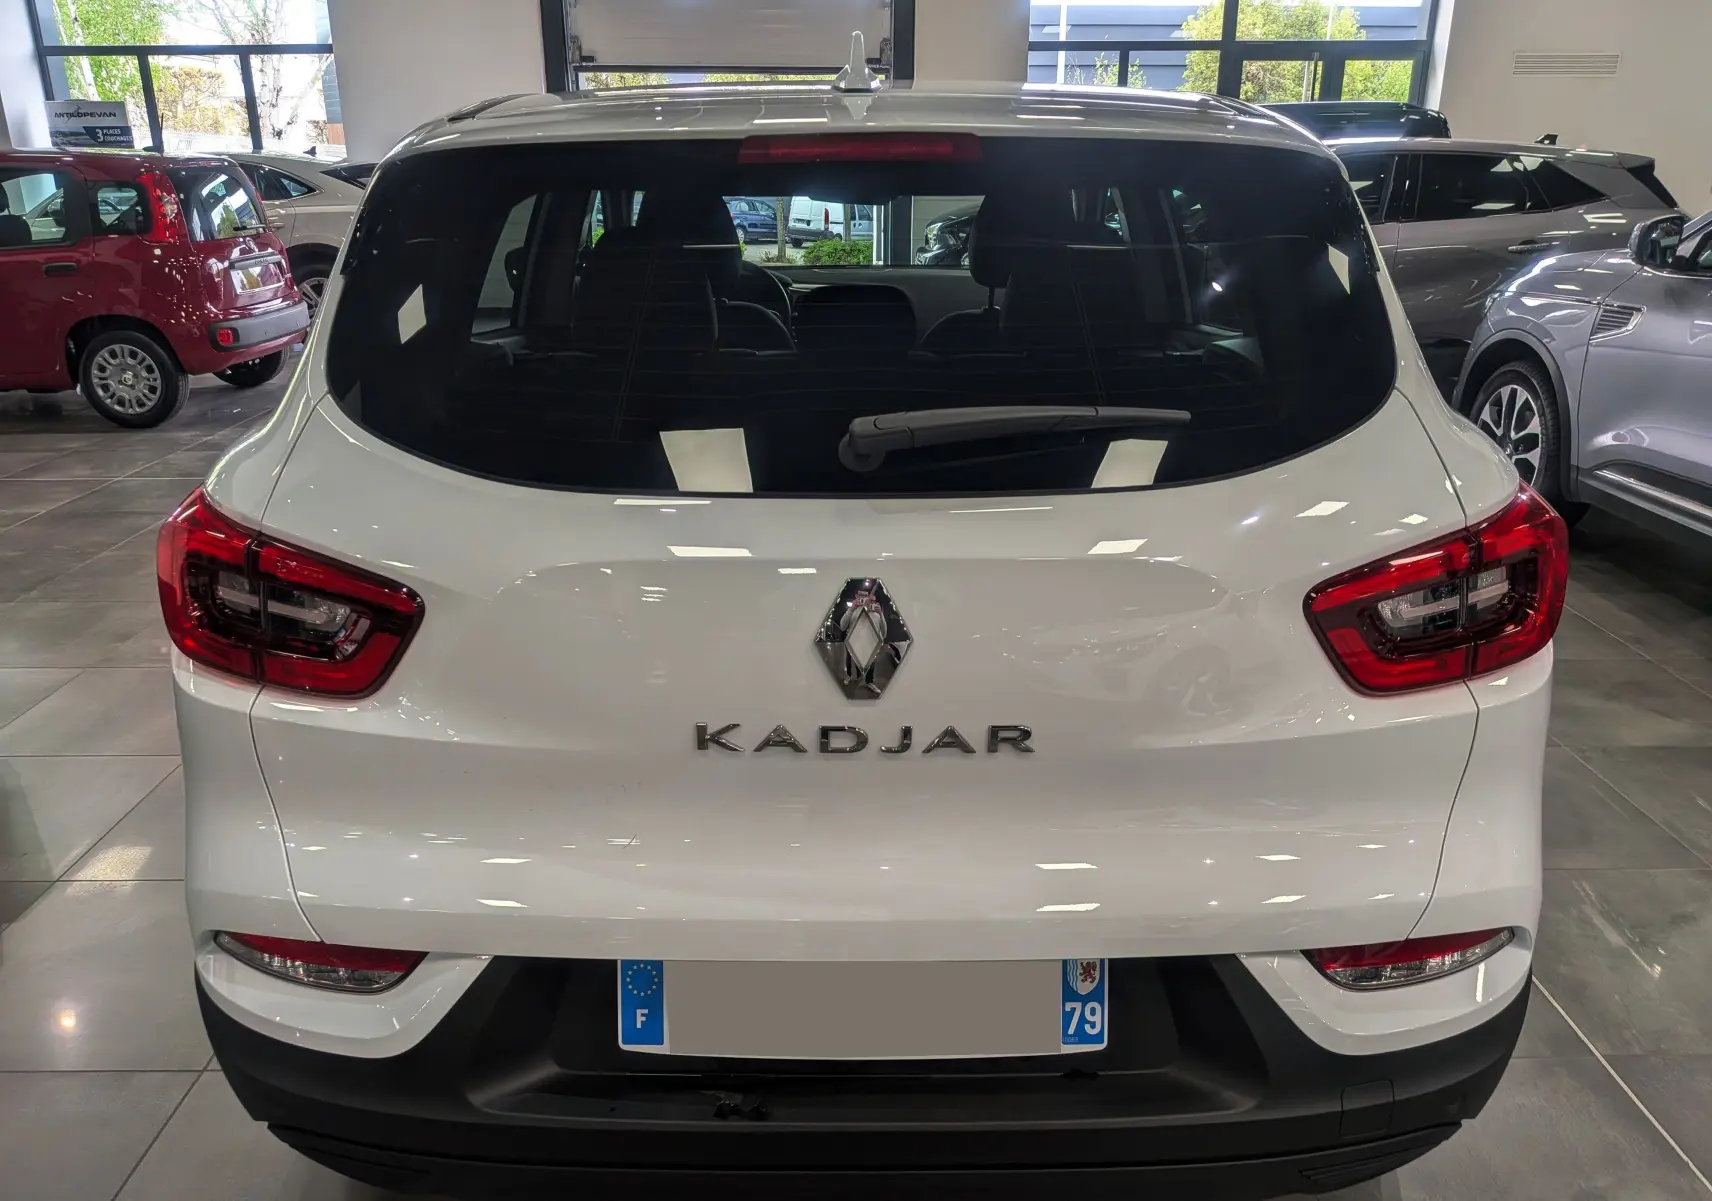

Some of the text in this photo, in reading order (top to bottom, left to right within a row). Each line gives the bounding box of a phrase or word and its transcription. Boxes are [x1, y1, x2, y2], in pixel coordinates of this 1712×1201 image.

[95, 128, 104, 142] 3
[696, 722, 1036, 754] KADJAR
[636, 1008, 649, 1029] F
[1064, 1001, 1102, 1035] 79
